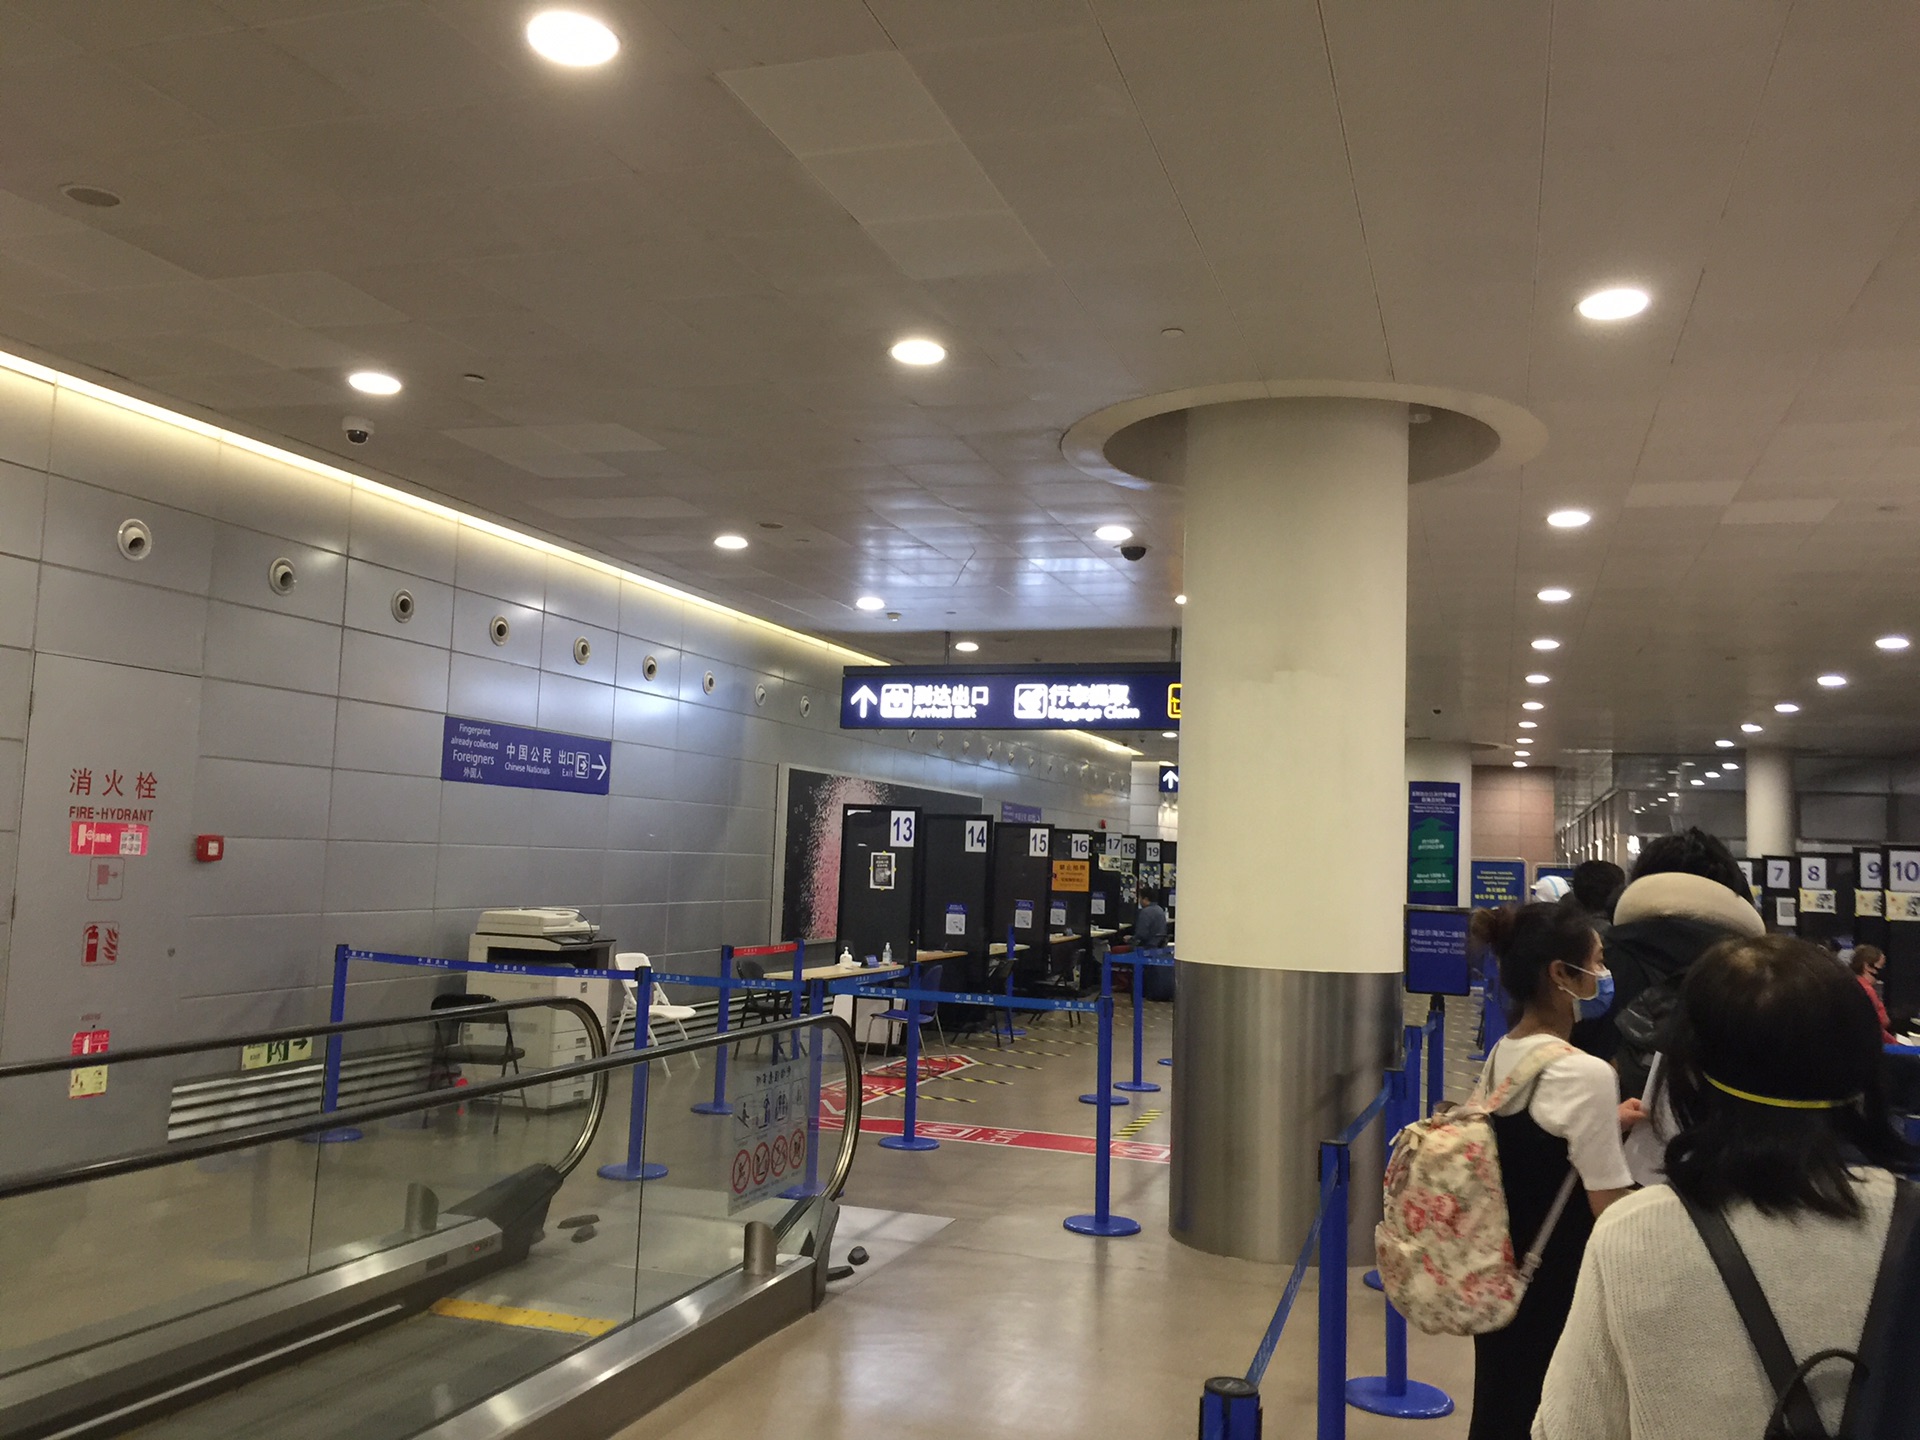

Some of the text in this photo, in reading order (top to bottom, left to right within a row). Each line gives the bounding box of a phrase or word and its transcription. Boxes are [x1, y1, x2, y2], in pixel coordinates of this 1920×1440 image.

[459, 723, 491, 737] Fingerprint
[450, 736, 499, 750] already collected
[452, 749, 495, 766] Foreigners
[506, 743, 574, 766] 中国公民 出口
[463, 767, 483, 779] 外国人
[504, 761, 573, 777] Chinese Nationals Exit
[69, 767, 158, 799] 消火栓
[69, 806, 154, 822] FIRE-HYDRANT
[893, 817, 913, 842] 13
[968, 825, 986, 848] 14
[1031, 833, 1047, 853] 15
[1073, 840, 1088, 853] 16
[1107, 838, 1120, 850] 17
[1123, 843, 1136, 854] 18
[1148, 847, 1159, 857] 19
[1772, 867, 1784, 882] 7
[1807, 865, 1820, 882] 8
[1867, 861, 1882, 879] 9
[1893, 861, 1920, 882] 10
